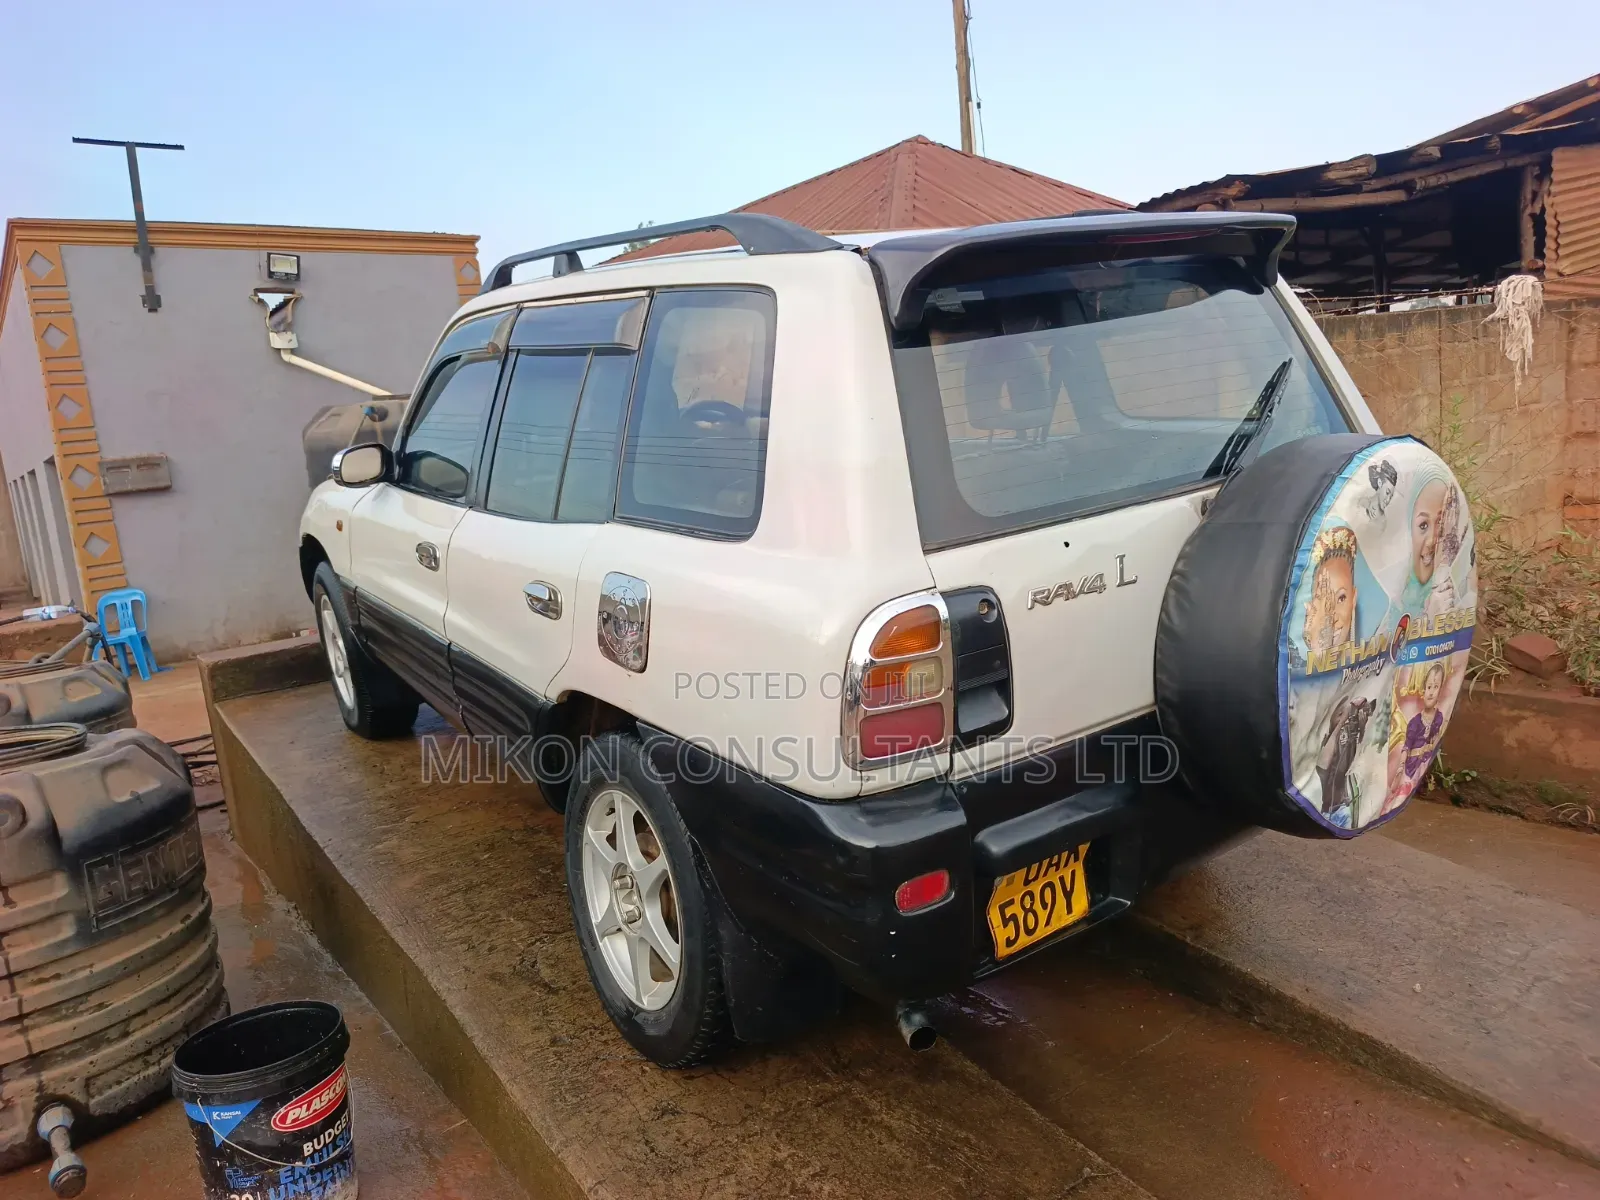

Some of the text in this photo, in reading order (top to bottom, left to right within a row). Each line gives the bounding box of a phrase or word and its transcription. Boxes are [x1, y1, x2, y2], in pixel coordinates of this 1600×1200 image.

[1027, 553, 1138, 610] RAV4 L
[1341, 655, 1385, 685] Photography
[997, 868, 1076, 948] 589Y
